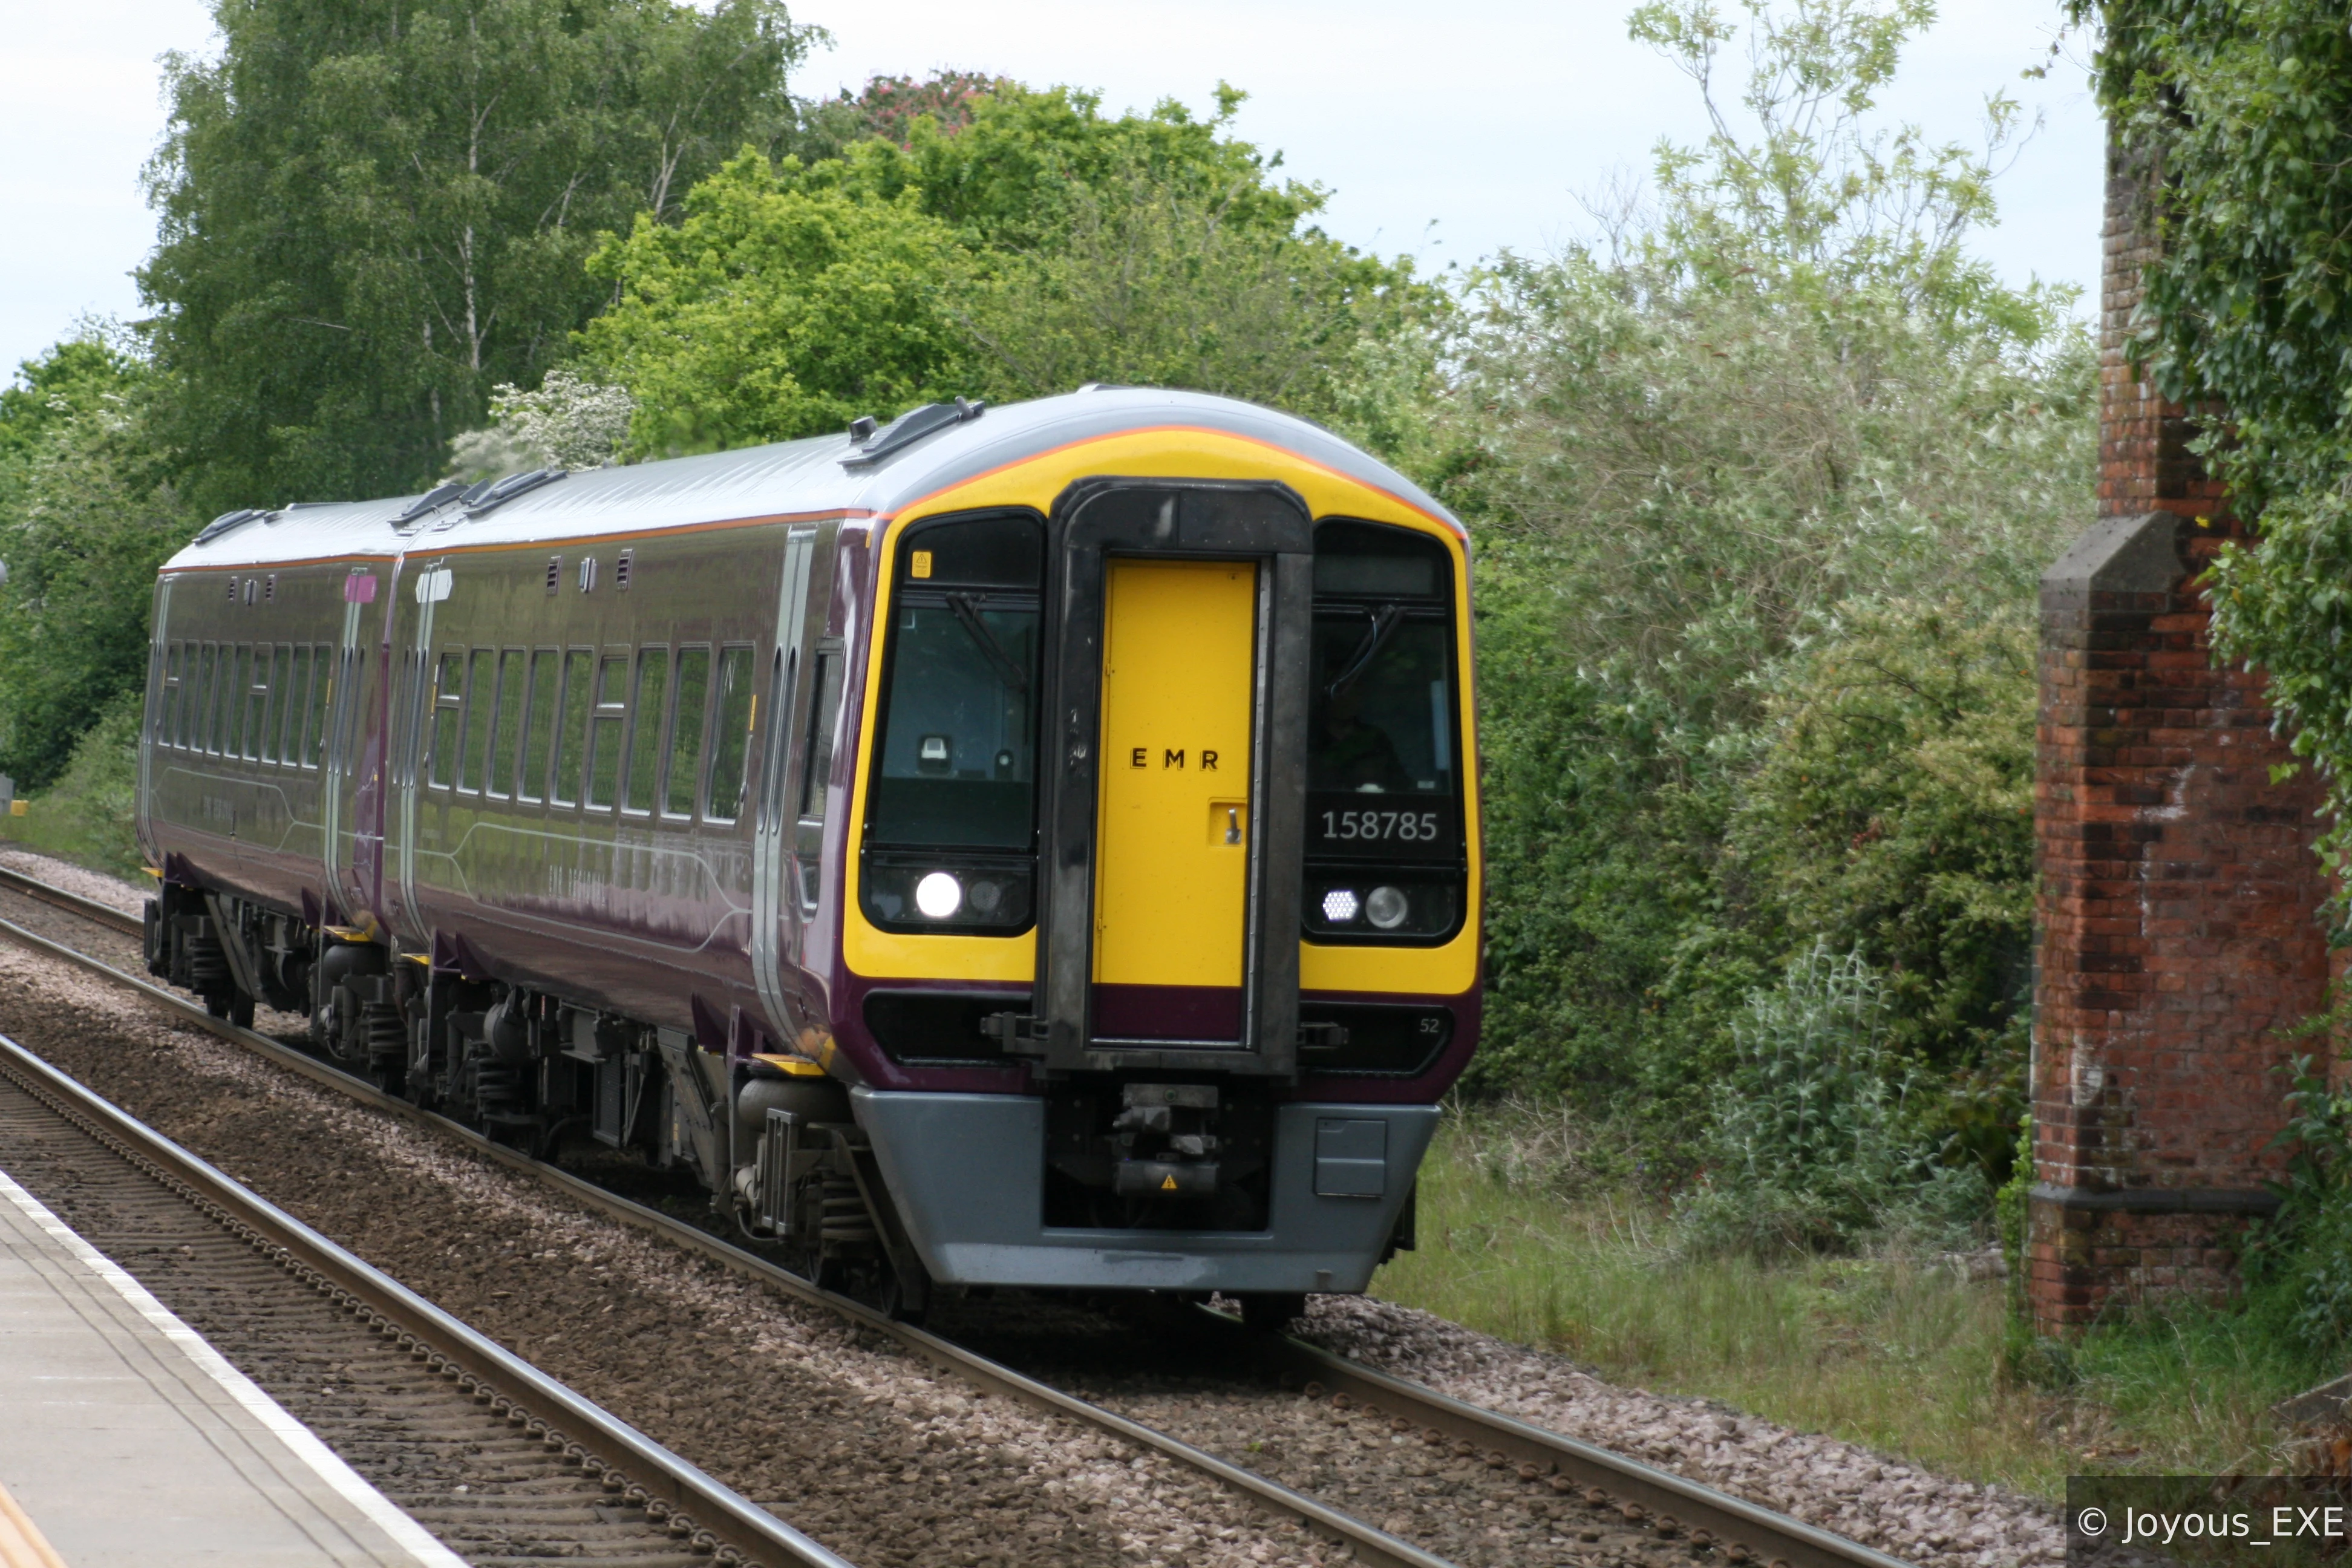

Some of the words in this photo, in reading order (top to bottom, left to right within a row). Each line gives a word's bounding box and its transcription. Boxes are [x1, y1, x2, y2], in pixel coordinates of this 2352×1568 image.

[1130, 748, 1218, 771] EMR
[1322, 811, 1437, 840] 158785
[1420, 1018, 1439, 1033] 52
